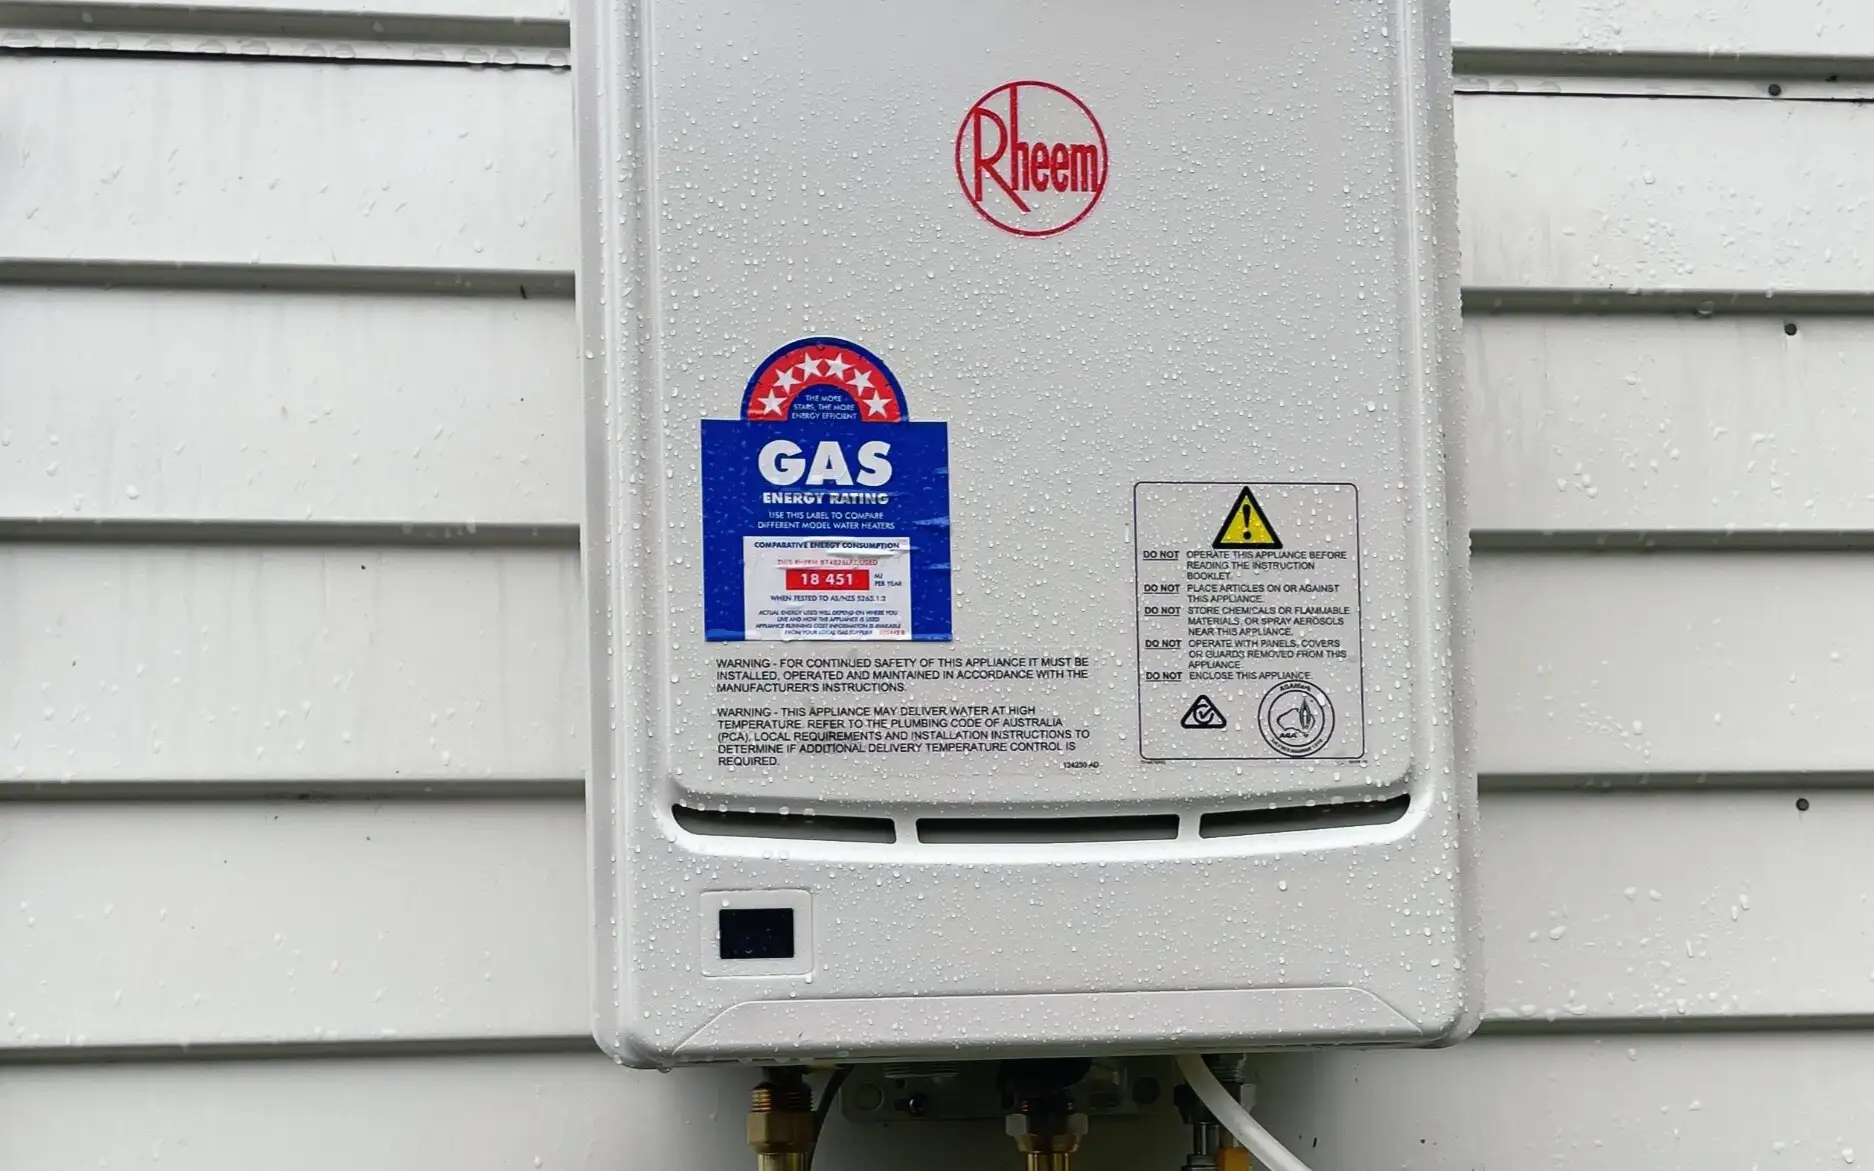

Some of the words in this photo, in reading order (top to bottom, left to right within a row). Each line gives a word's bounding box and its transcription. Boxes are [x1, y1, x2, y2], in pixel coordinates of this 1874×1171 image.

[974, 85, 1097, 212] Rheem
[758, 440, 892, 486] GAS
[763, 492, 822, 504] ENERGY
[829, 492, 889, 504] RATING
[801, 574, 819, 585] 18
[826, 574, 853, 585] 451
[1244, 618, 1258, 626] OR
[1261, 618, 1291, 626] SPRAY
[1294, 618, 1344, 626] AEROSOLS
[716, 659, 770, 668] WARNING
[780, 659, 803, 667] FOR
[806, 659, 871, 667] CONTINUED
[874, 658, 916, 667] SAFETY
[920, 658, 935, 666] OF
[938, 658, 962, 666] THIS
[966, 658, 1025, 666] APPLIANCE
[1029, 658, 1038, 666] IT
[1041, 657, 1072, 666] MUST
[1075, 657, 1088, 666] BE
[717, 671, 780, 680] INSTALLED,
[783, 671, 843, 680] OPERATED
[846, 670, 869, 680] AND
[873, 670, 940, 679] MAINTAINED
[943, 670, 954, 679] IN
[956, 670, 1033, 679] ACCORDANCE
[1036, 670, 1063, 679] WITH
[1067, 669, 1088, 678] THE
[717, 684, 819, 692] MANUFACTURER'S
[822, 683, 906, 691] INSTRUCTIONS.
[717, 708, 771, 717] WARNING
[781, 708, 805, 716] THIS
[809, 708, 870, 716] APPLIANCE
[874, 708, 897, 716] MAY
[901, 707, 947, 716] DELIVER
[950, 707, 989, 716] WATER
[992, 707, 1005, 715] AT
[1009, 707, 1035, 715] HIGH
[808, 720, 844, 728] REFER
[849, 720, 864, 728] TO
[867, 720, 887, 728] THE
[891, 719, 948, 728] PLUMBING
[950, 719, 981, 728] CODE
[985, 719, 999, 727] OF
[1003, 719, 1062, 727] AUSTRALIA
[754, 732, 790, 742] LOCAL
[794, 732, 882, 741] REQUIREMENTS
[885, 731, 908, 741] AND
[911, 731, 988, 741] INSTALLATION
[991, 731, 1072, 740] INSTRUCTIONS
[1075, 730, 1090, 740] TO
[718, 744, 783, 753] DETERMINE
[787, 744, 796, 753] IF
[799, 744, 866, 753] ADDITIONAL
[869, 744, 922, 752] DELIVERY
[926, 743, 1007, 752] TEMPERATURE
[1010, 743, 1062, 752] CONTROL
[1066, 743, 1076, 752] IS
[718, 757, 779, 766] REQUIRED.
